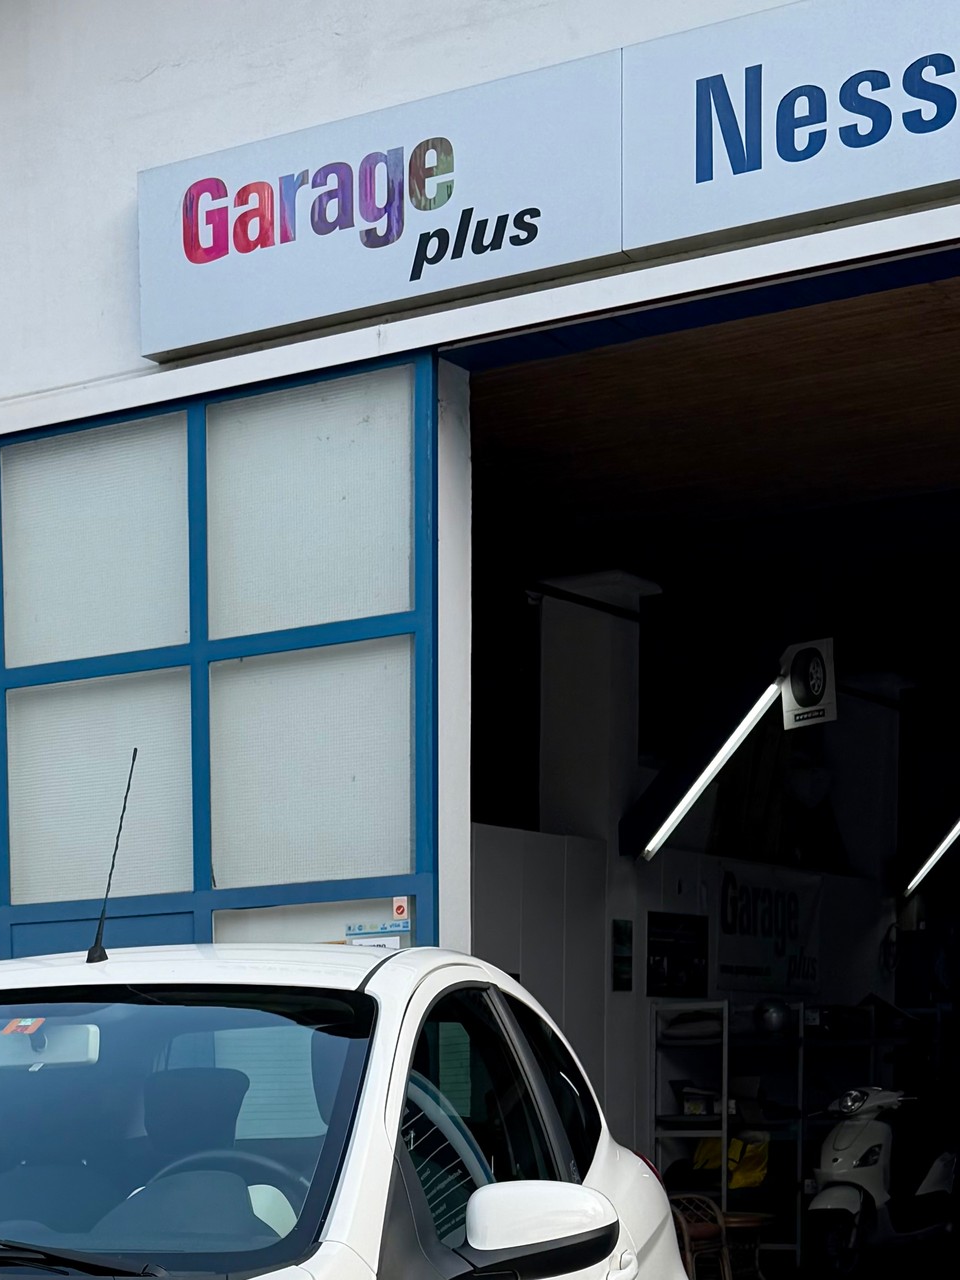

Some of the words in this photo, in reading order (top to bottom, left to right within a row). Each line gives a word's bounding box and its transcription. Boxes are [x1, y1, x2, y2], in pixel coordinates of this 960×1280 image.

[695, 53, 958, 184] Ness
[182, 136, 455, 266] Garage
[410, 207, 541, 282] plus
[721, 871, 799, 957] Garage
